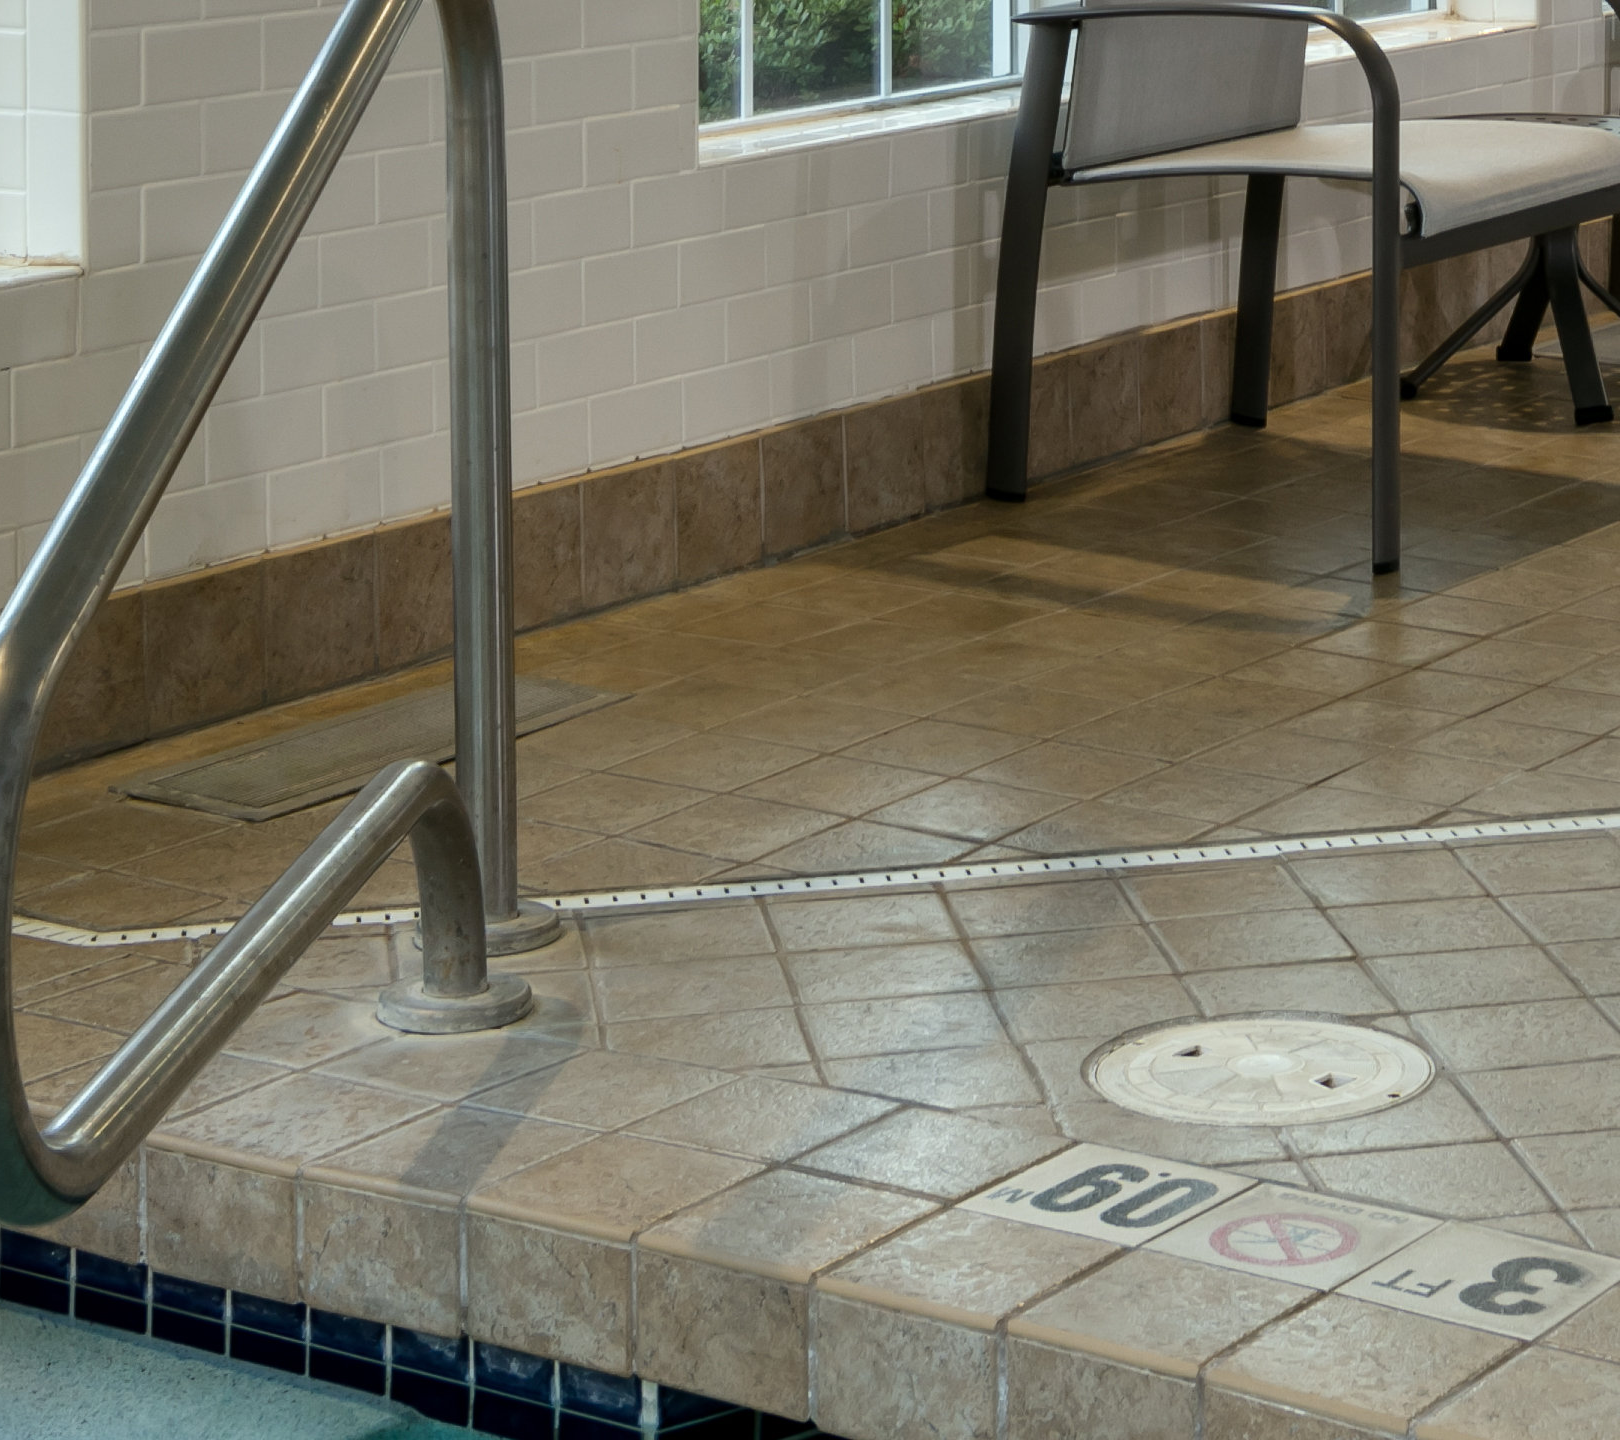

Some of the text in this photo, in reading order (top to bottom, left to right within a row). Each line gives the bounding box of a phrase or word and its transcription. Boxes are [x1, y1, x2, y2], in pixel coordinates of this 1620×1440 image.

[1272, 1192, 1409, 1226] NO DIVING
[1372, 1269, 1453, 1299] FT
[1457, 1256, 1582, 1318] 3
